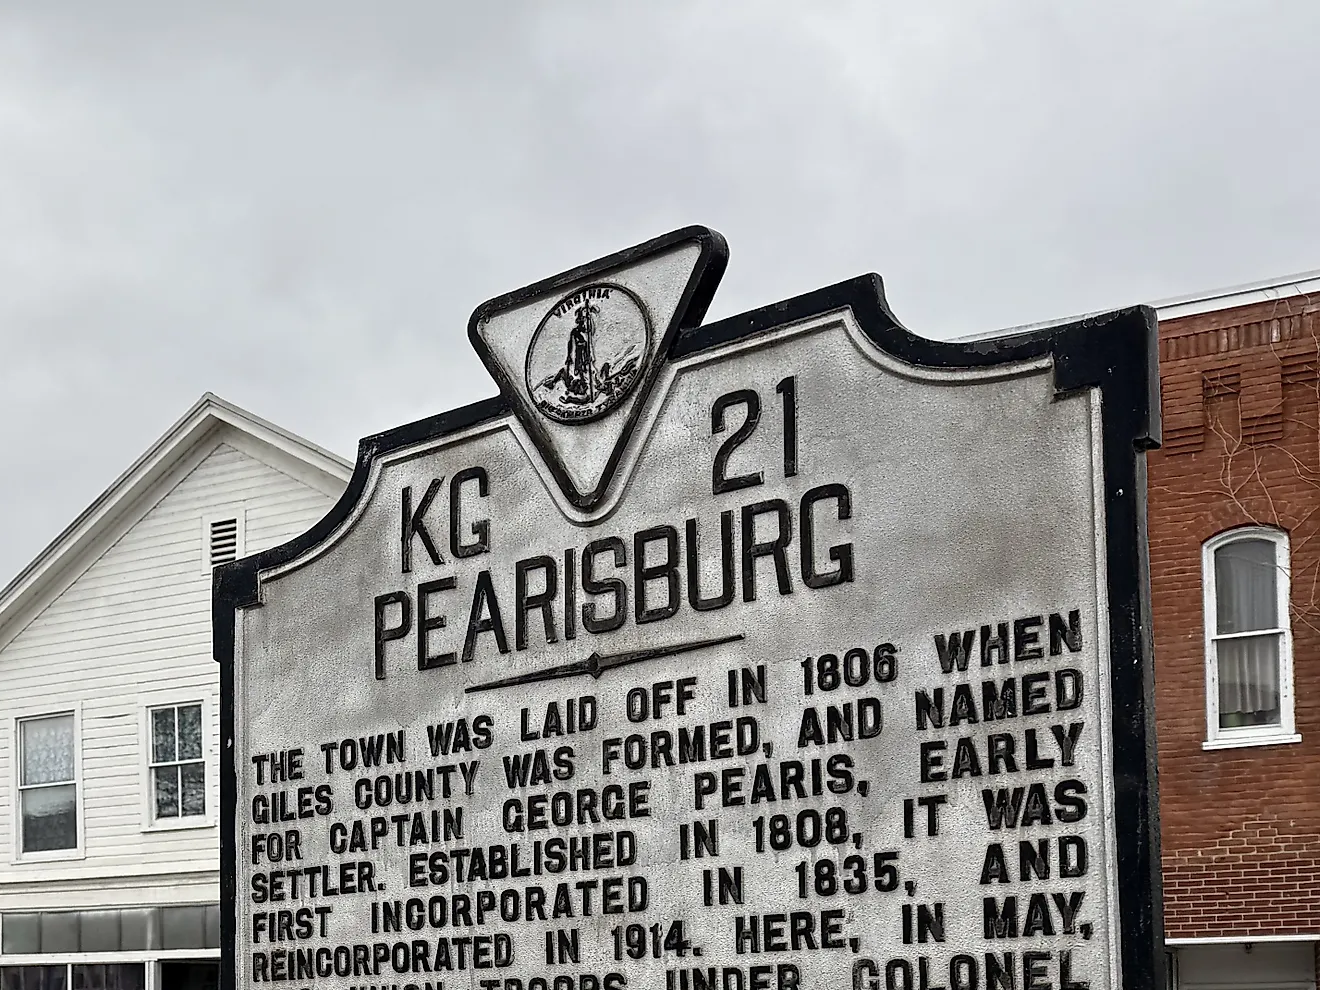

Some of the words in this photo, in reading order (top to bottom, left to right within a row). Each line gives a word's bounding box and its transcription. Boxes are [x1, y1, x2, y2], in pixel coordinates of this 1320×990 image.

[401, 466, 491, 573] KG
[711, 375, 799, 495] 21
[374, 483, 854, 681] PEARISBURG
[252, 748, 305, 785] THE
[321, 730, 405, 774] TOWN
[428, 715, 494, 756] WAS
[521, 696, 597, 741] LAID
[626, 676, 697, 723] OFF
[728, 664, 766, 707] IN
[800, 643, 898, 695] 1806
[934, 609, 1082, 674] WHEN
[252, 784, 333, 824] GILES
[355, 760, 480, 809] COUNTY
[503, 746, 575, 788] WAS
[602, 716, 773, 774] FORMED,
[798, 697, 883, 747] AND
[915, 668, 1084, 730] NAMED
[252, 829, 302, 864] FOR
[330, 806, 463, 854] CAPTAIN
[503, 781, 651, 832] GEORGE
[694, 753, 870, 810] PEARIS,
[920, 722, 1085, 783] EARLY
[252, 861, 386, 903] SETTLER.
[410, 830, 637, 888] ESTABLISHED
[680, 819, 718, 860] IN
[752, 806, 863, 853] 1808,
[903, 795, 947, 838] IT
[982, 779, 1088, 830] WAS
[252, 906, 332, 943] FIRST
[371, 875, 649, 933] INCORPORATED
[702, 866, 744, 906] IN
[795, 851, 918, 899] 1835,
[980, 836, 1088, 885] AND
[252, 933, 514, 982] REINCORPORATED
[546, 928, 580, 964] IN
[611, 919, 702, 961] 1914.
[735, 909, 860, 954] HERE,
[902, 902, 945, 944] IN
[983, 891, 1093, 940] MAY,
